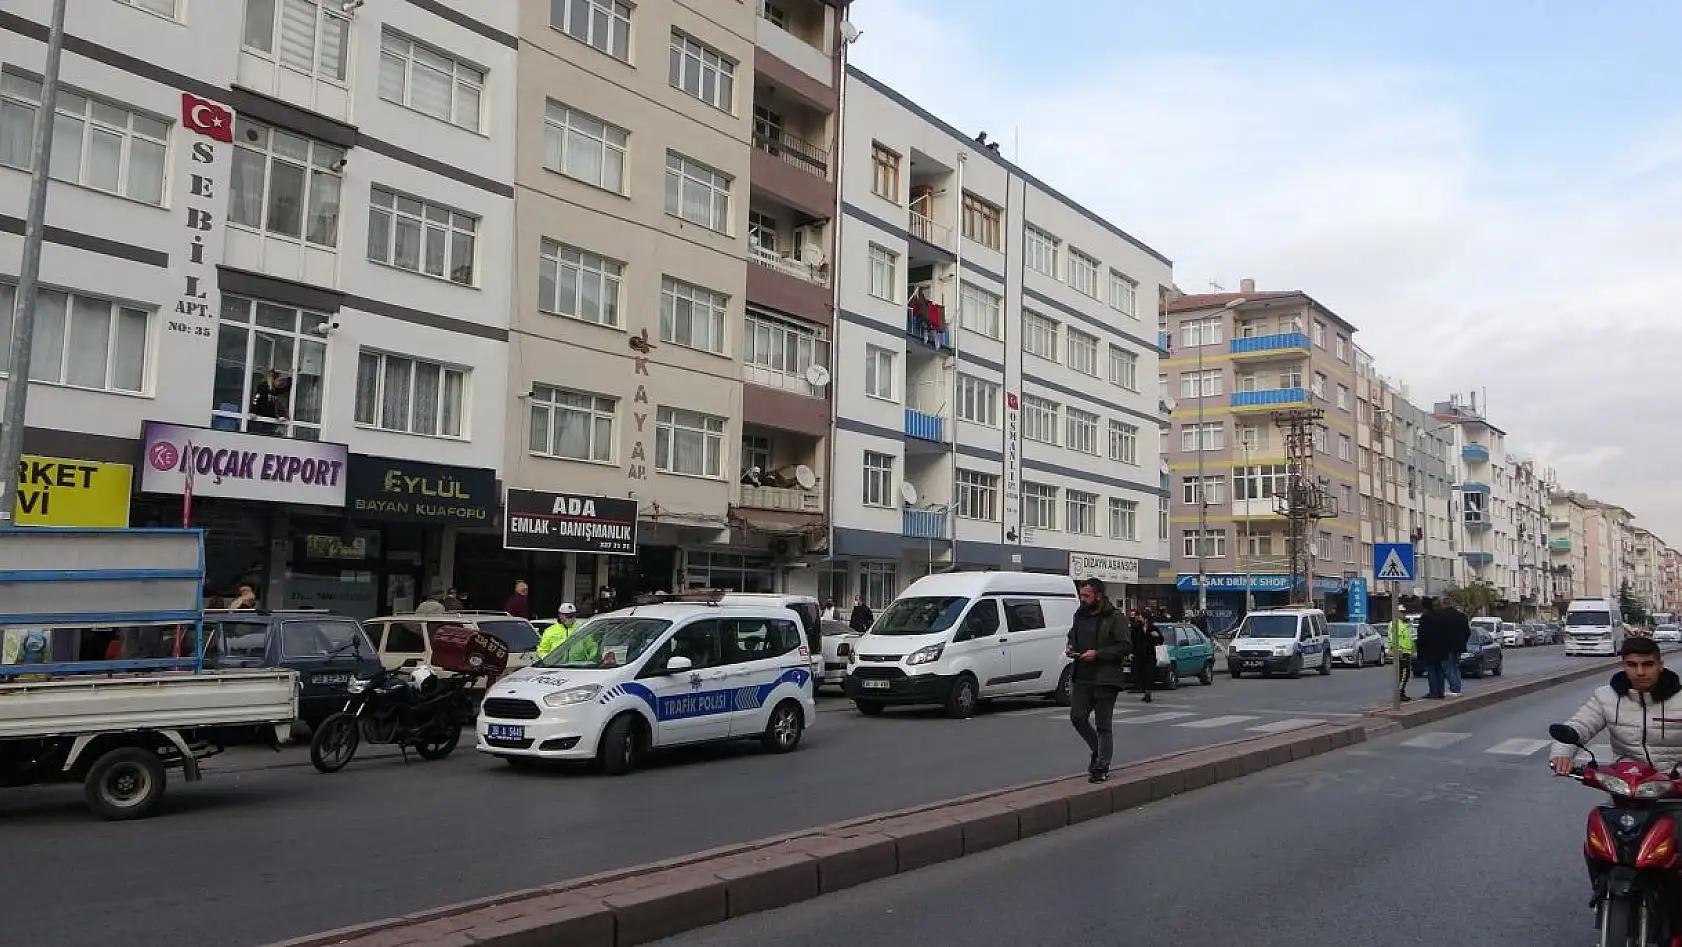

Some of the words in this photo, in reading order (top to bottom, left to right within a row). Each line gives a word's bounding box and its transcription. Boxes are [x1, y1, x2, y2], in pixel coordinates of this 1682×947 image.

[185, 141, 214, 299] SEBİL
[260, 453, 344, 487] EXPORT
[384, 469, 470, 499] EYLÜL
[355, 499, 409, 513] BAYAN
[552, 496, 596, 517] ADA
[510, 517, 549, 534] EMLAK
[560, 521, 631, 541] DANIŞMANLIK
[1260, 577, 1287, 586] SHOP
[664, 694, 697, 716] TRAFİK
